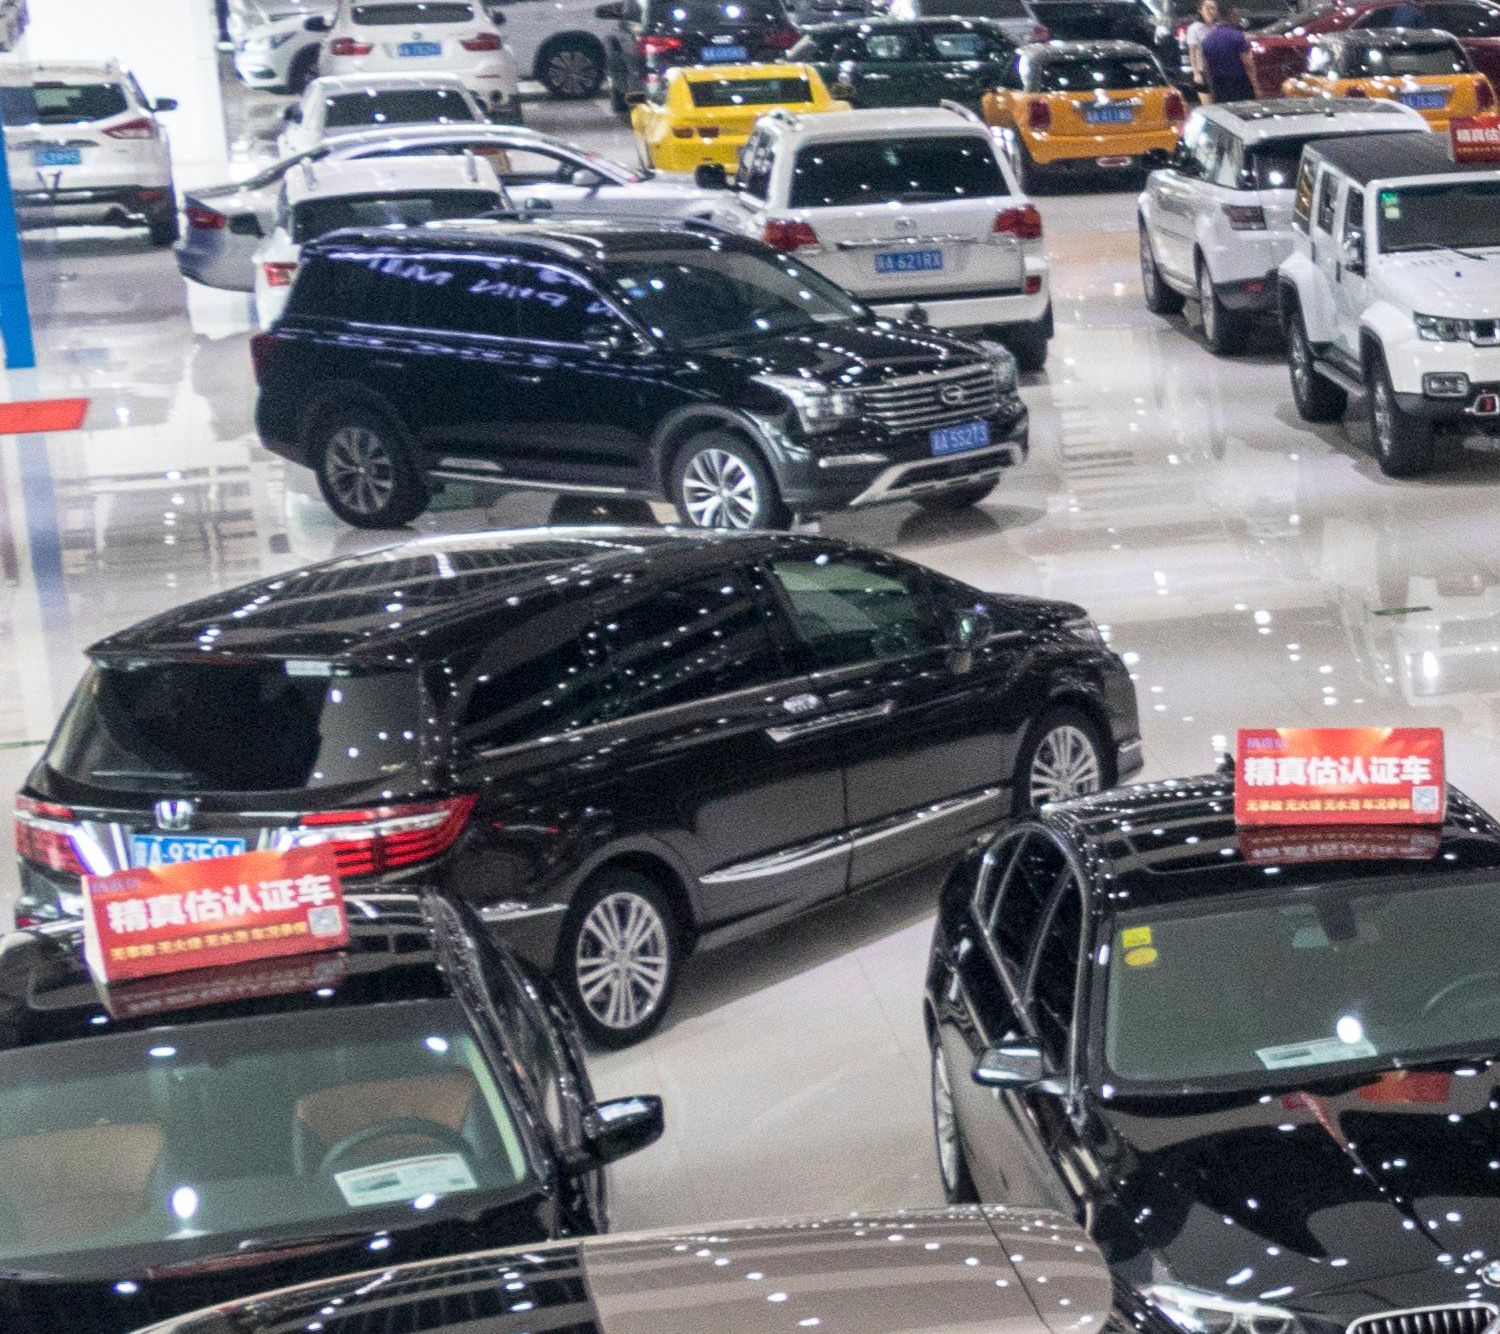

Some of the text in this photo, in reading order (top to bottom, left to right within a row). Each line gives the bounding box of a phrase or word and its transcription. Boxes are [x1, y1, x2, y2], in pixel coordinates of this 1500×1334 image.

[1244, 756, 1432, 786] 精真估认证车
[107, 874, 337, 934] 精真估认证车
